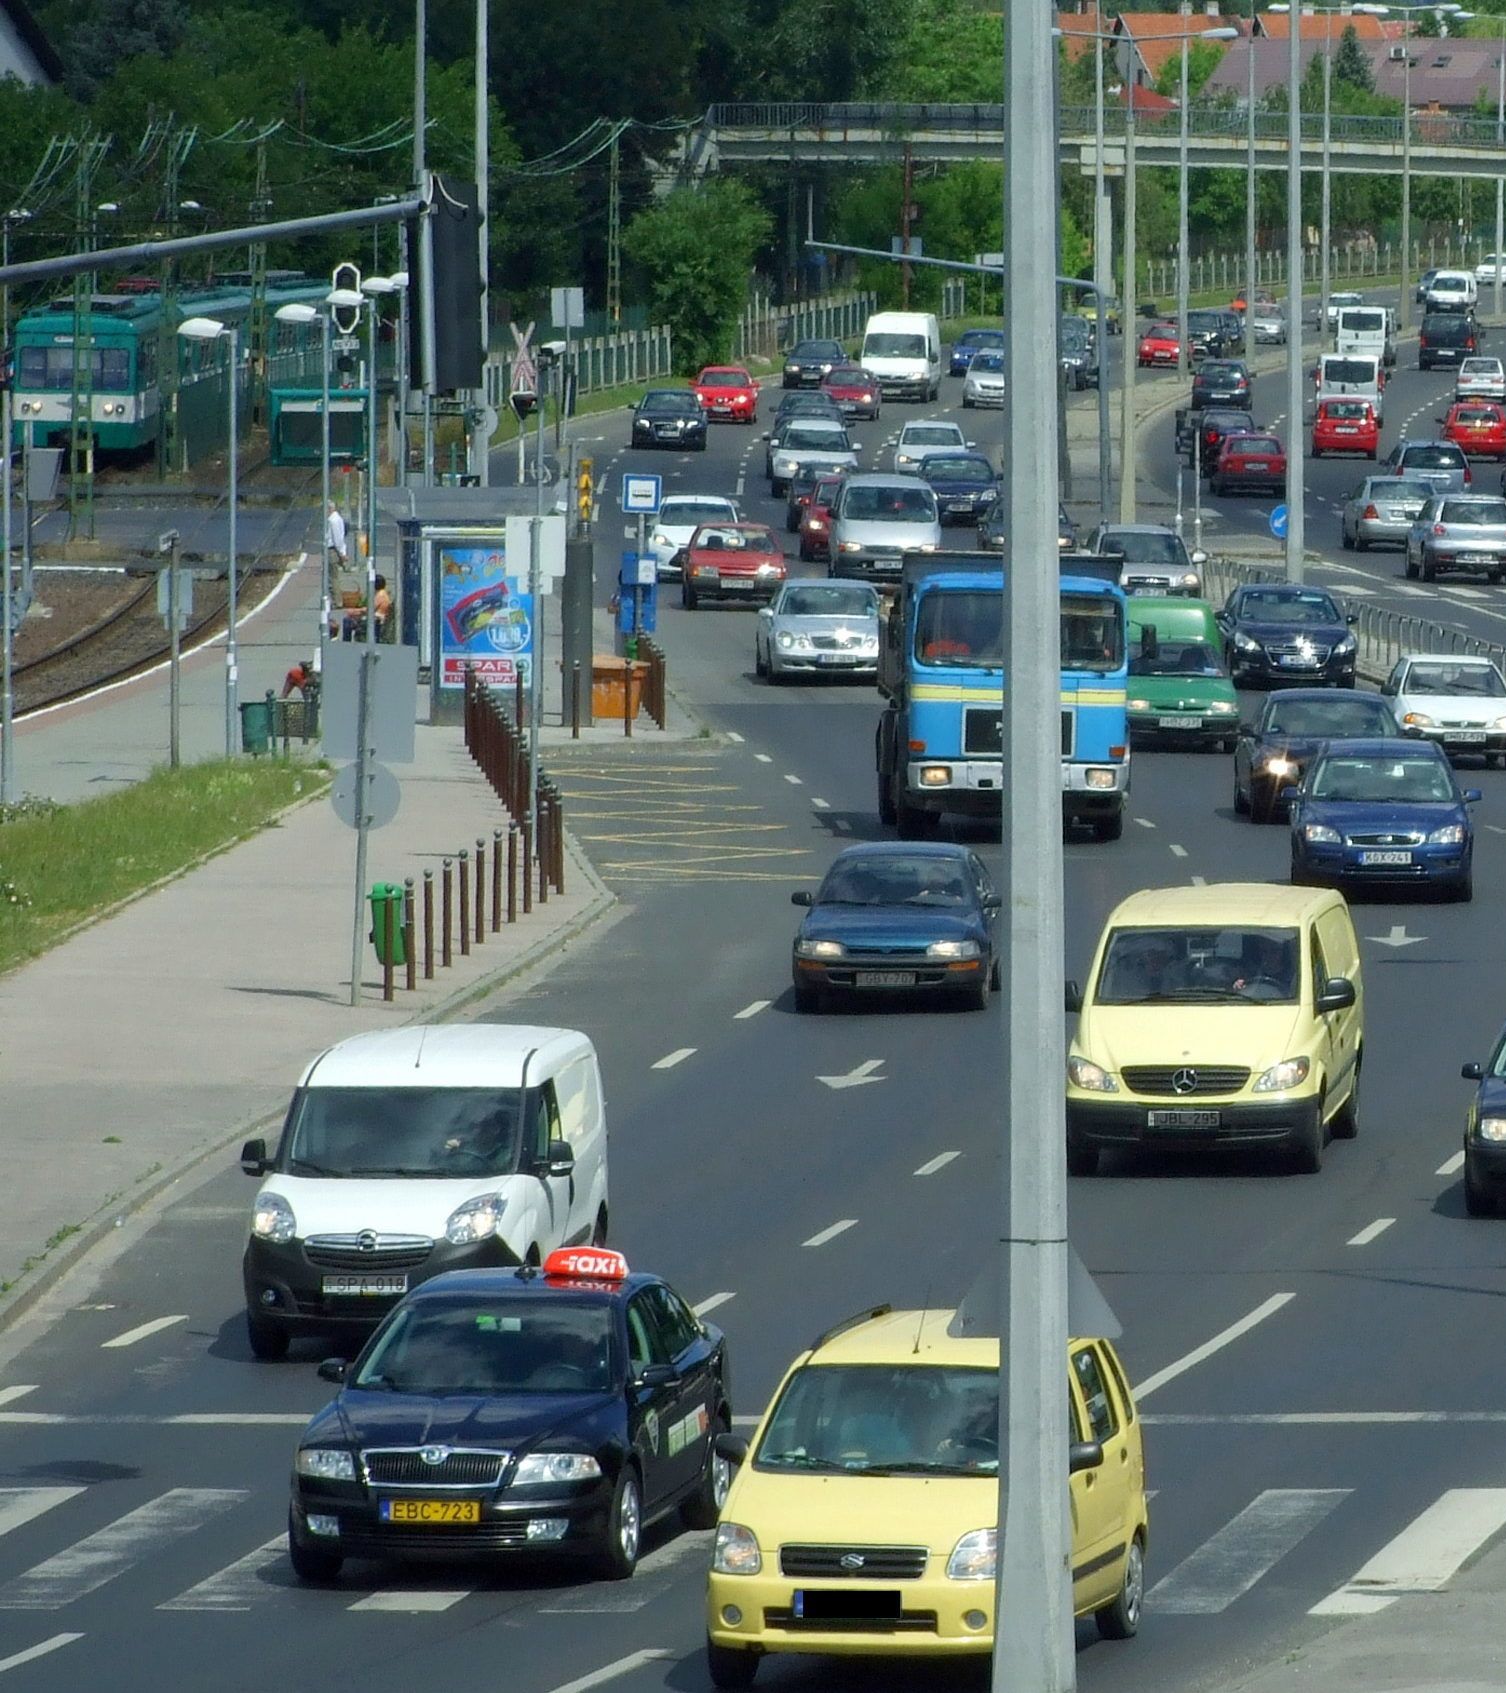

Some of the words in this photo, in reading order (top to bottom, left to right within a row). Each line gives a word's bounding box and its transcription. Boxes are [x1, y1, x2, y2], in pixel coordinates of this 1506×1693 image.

[456, 660, 511, 671] SPAR
[1159, 1113, 1218, 1125] JBL-295
[336, 1276, 405, 1292] SPA-018
[393, 1502, 474, 1520] EBC-723
